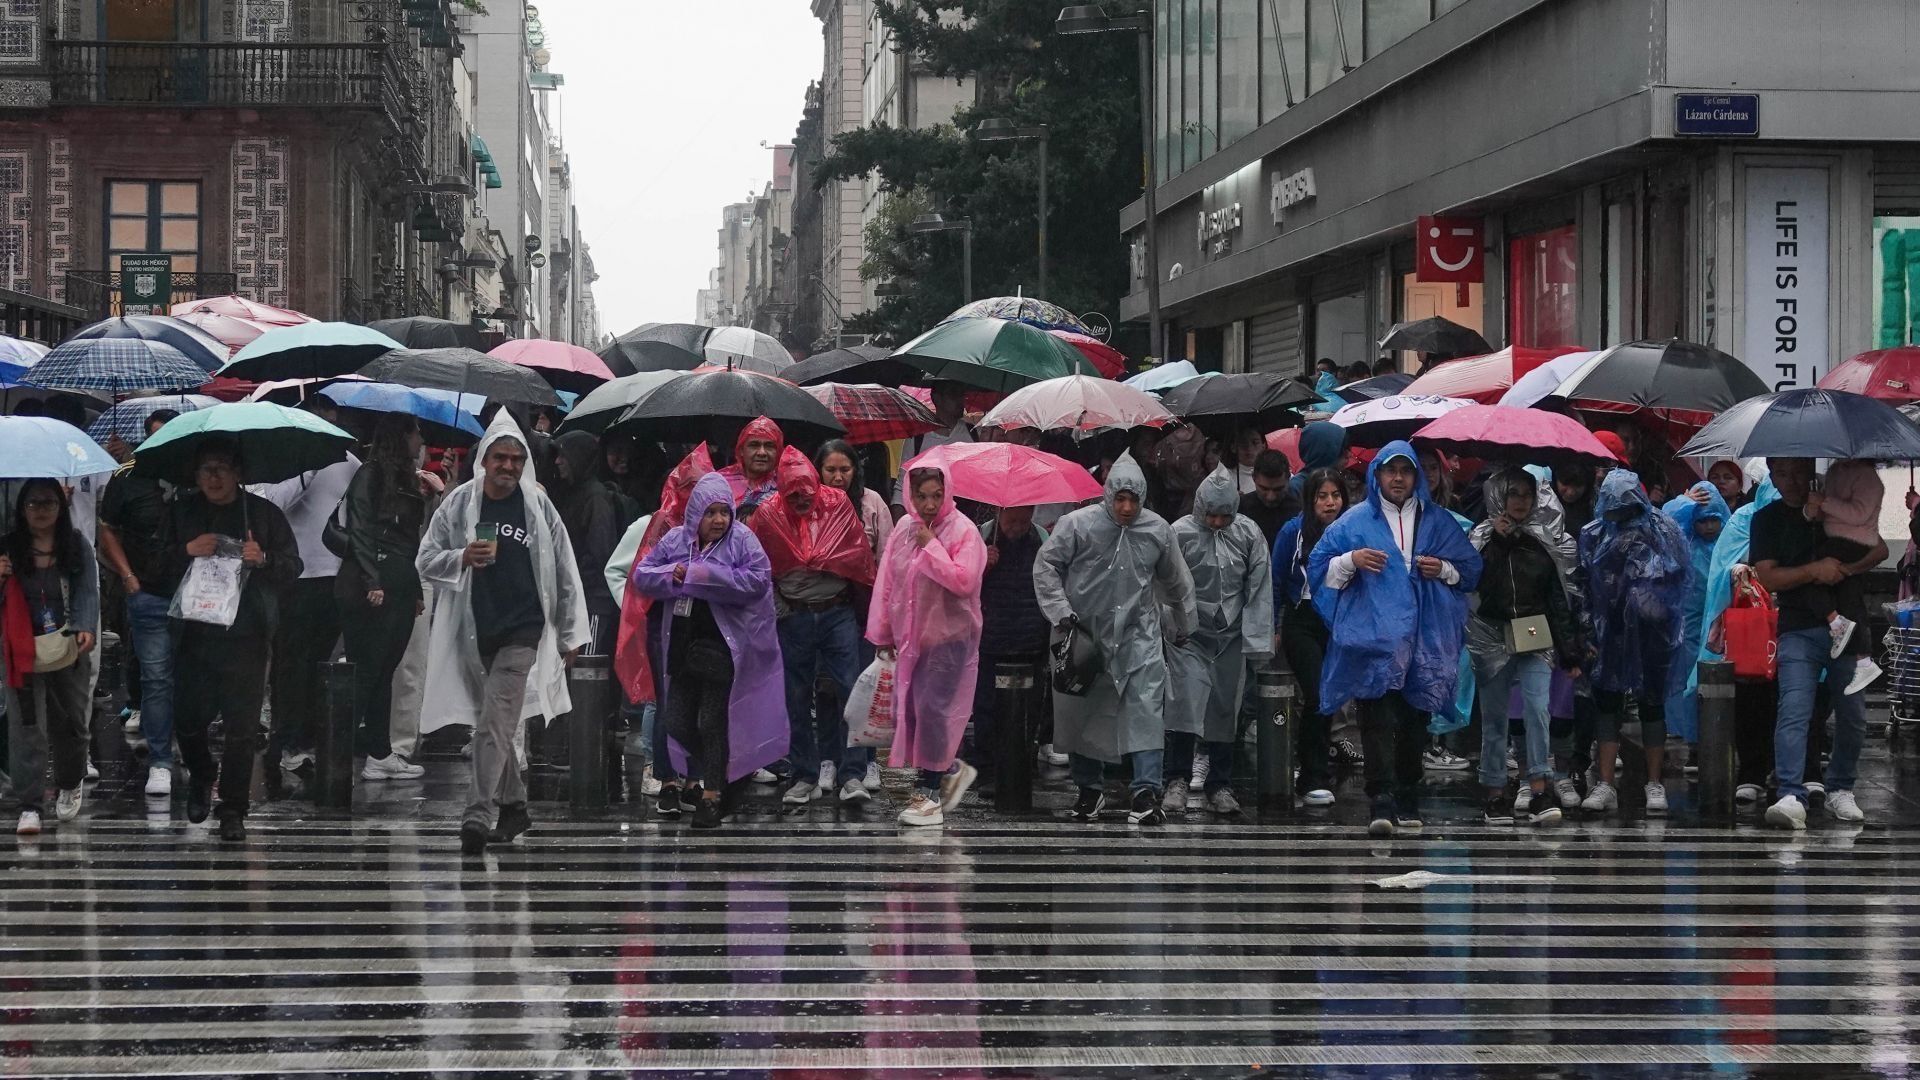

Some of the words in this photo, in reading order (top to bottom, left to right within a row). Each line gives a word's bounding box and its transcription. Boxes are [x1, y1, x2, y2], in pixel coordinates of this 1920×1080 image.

[1703, 97, 1712, 106] Eje
[1712, 97, 1731, 105] Central
[1685, 108, 1712, 120] Lázaro
[1713, 108, 1749, 120] Cárdenas
[1775, 201, 1798, 257] LIFE
[1775, 266, 1798, 289] IS
[1775, 298, 1797, 353] FOR
